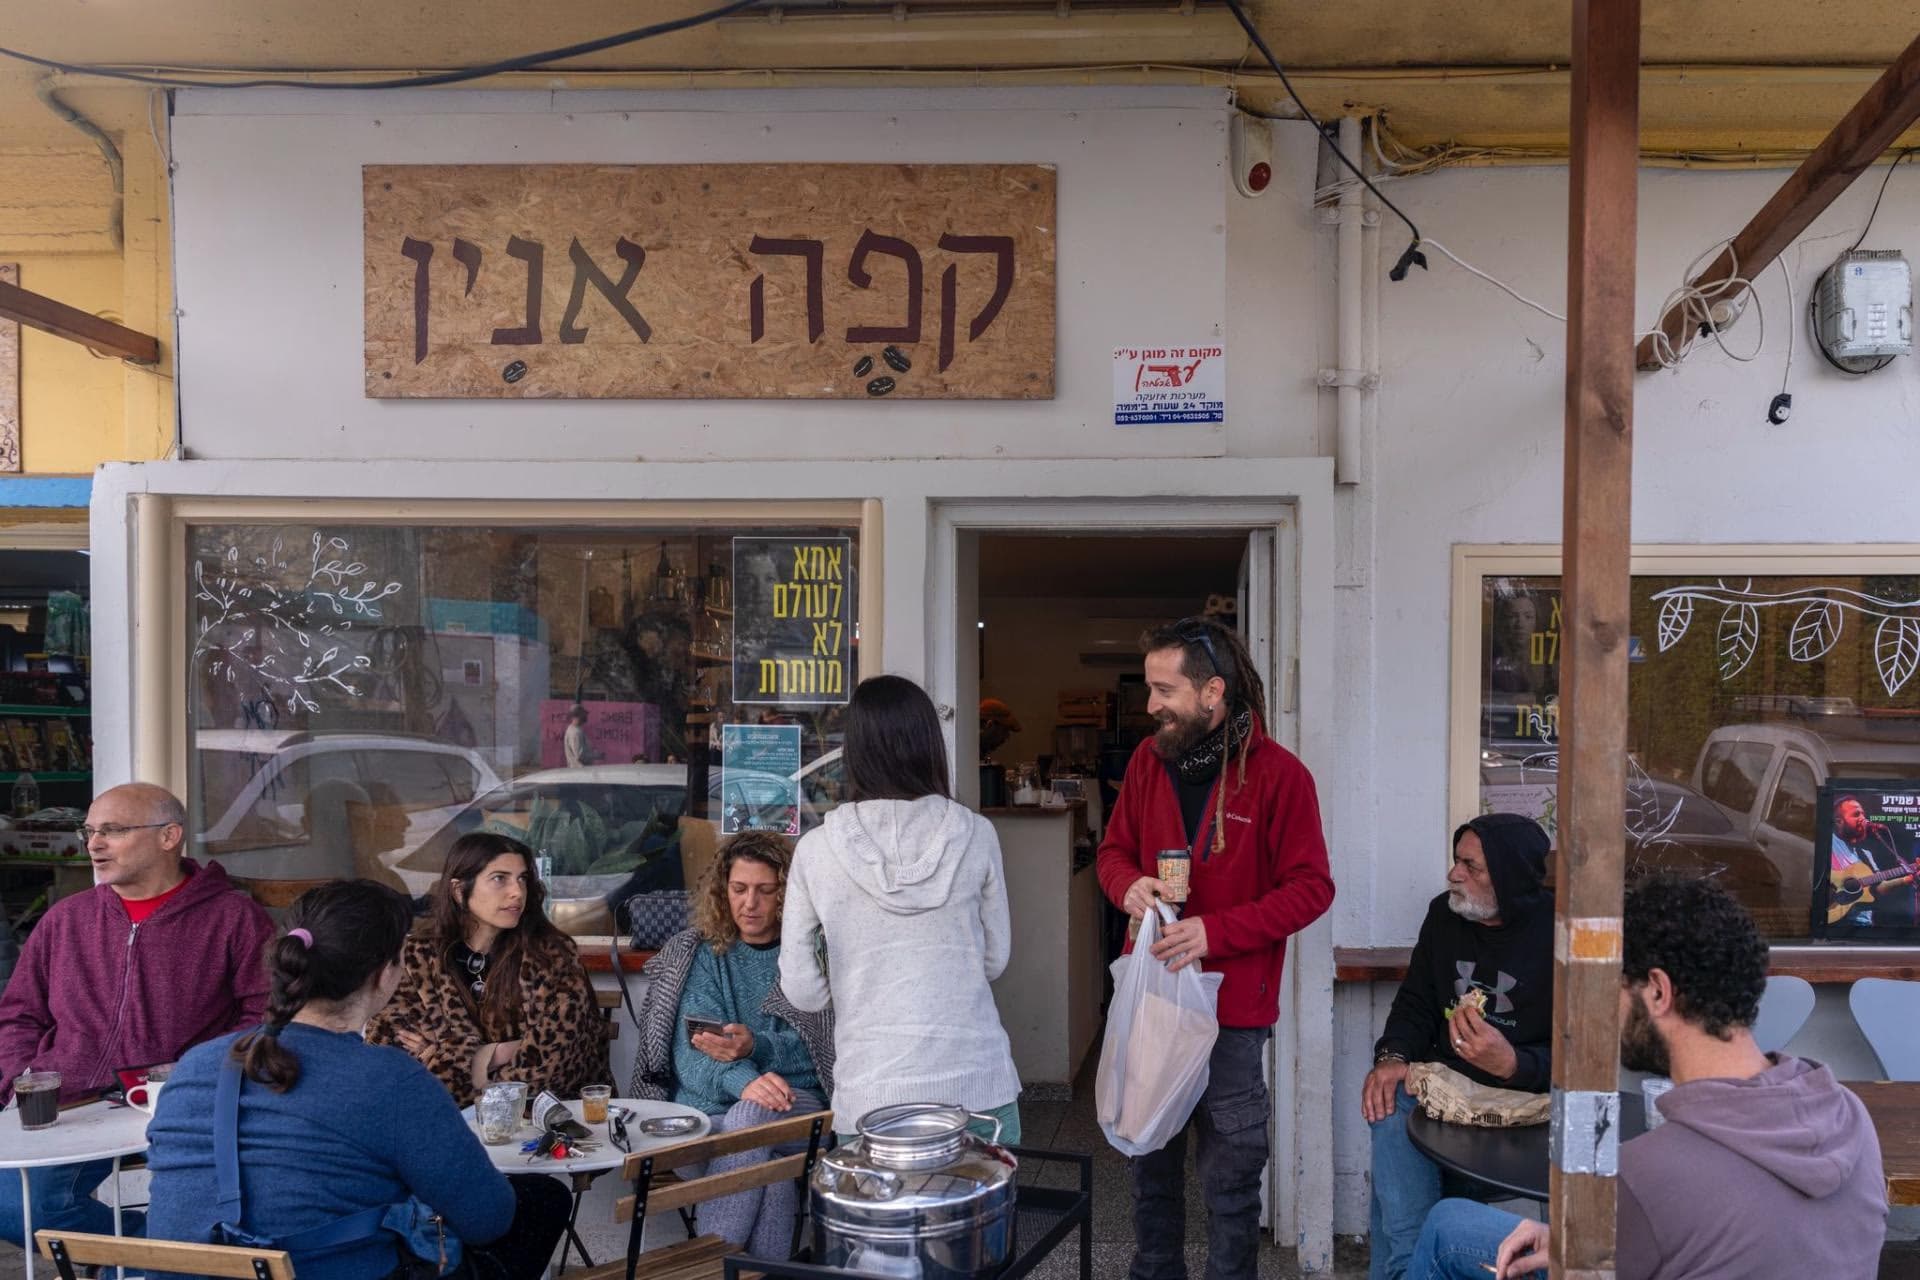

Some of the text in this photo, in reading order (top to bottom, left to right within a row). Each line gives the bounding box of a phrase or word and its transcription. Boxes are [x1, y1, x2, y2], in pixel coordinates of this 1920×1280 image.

[401, 229, 1015, 374] קפה אנין
[1142, 349, 1167, 361] מוגן
[1170, 349, 1185, 358] זה
[1189, 348, 1222, 360] מקום
[1116, 401, 1223, 411] מוקד 24 שעות ביממה
[1135, 392, 1206, 402] מערכות אזעקה
[793, 546, 843, 580] אמא
[773, 581, 843, 618] לעולם
[812, 620, 843, 656] לא
[759, 659, 843, 694] מוותרת
